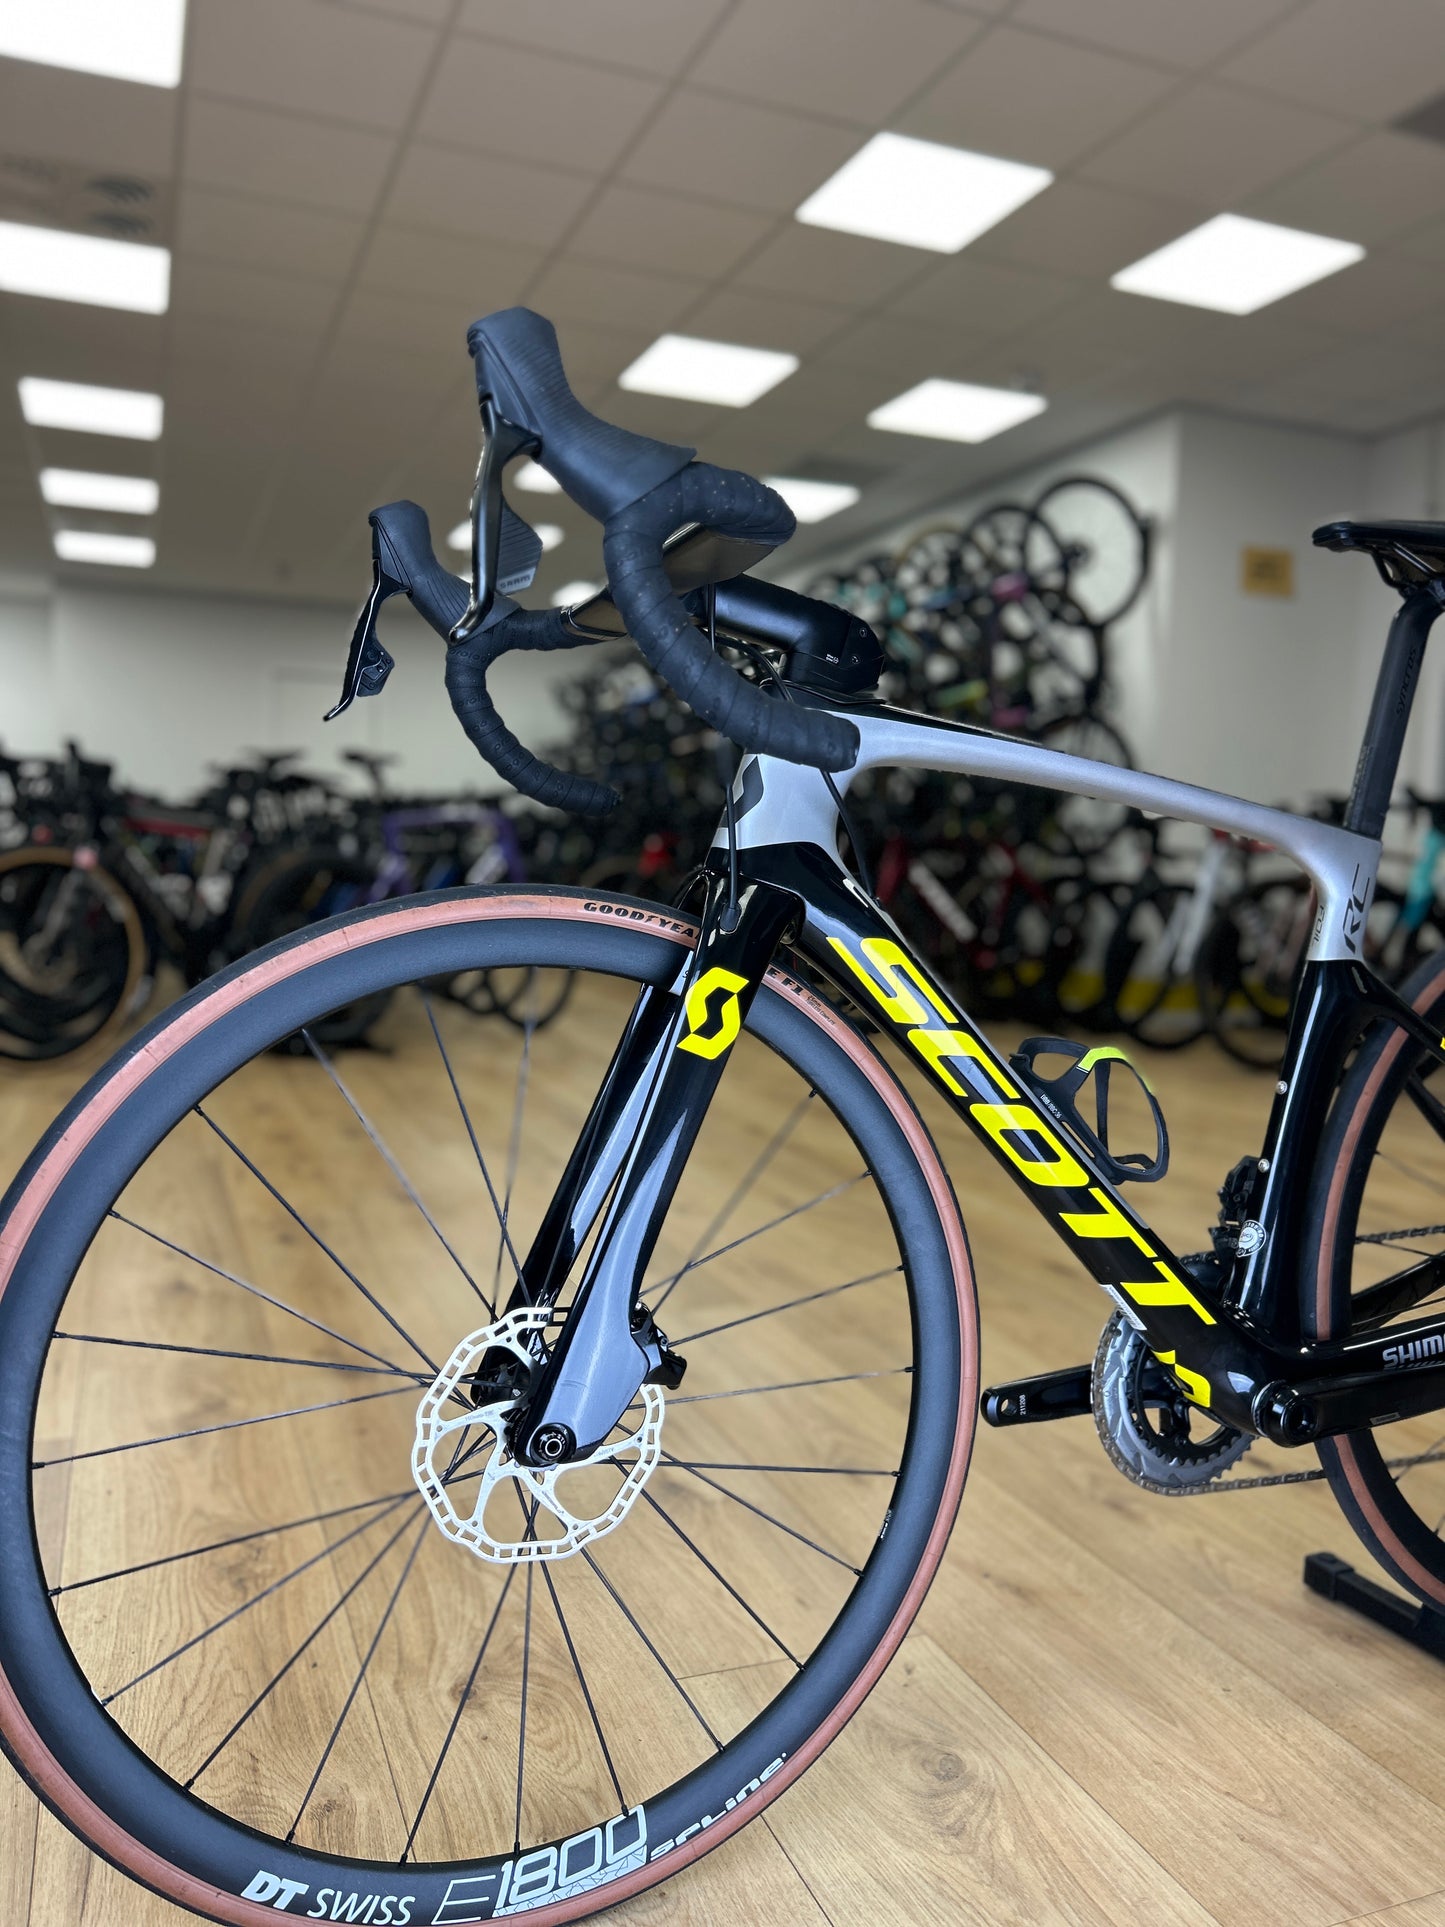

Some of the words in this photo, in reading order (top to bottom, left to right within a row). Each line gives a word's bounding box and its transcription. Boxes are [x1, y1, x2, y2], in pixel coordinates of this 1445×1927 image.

[583, 902, 701, 940] GOODYEA
[1342, 863, 1370, 955] RC
[825, 936, 1217, 1326] SCOTT
[1382, 1334, 1445, 1368] SHIM
[240, 1869, 310, 1911] DT
[306, 1887, 416, 1926] SWISS
